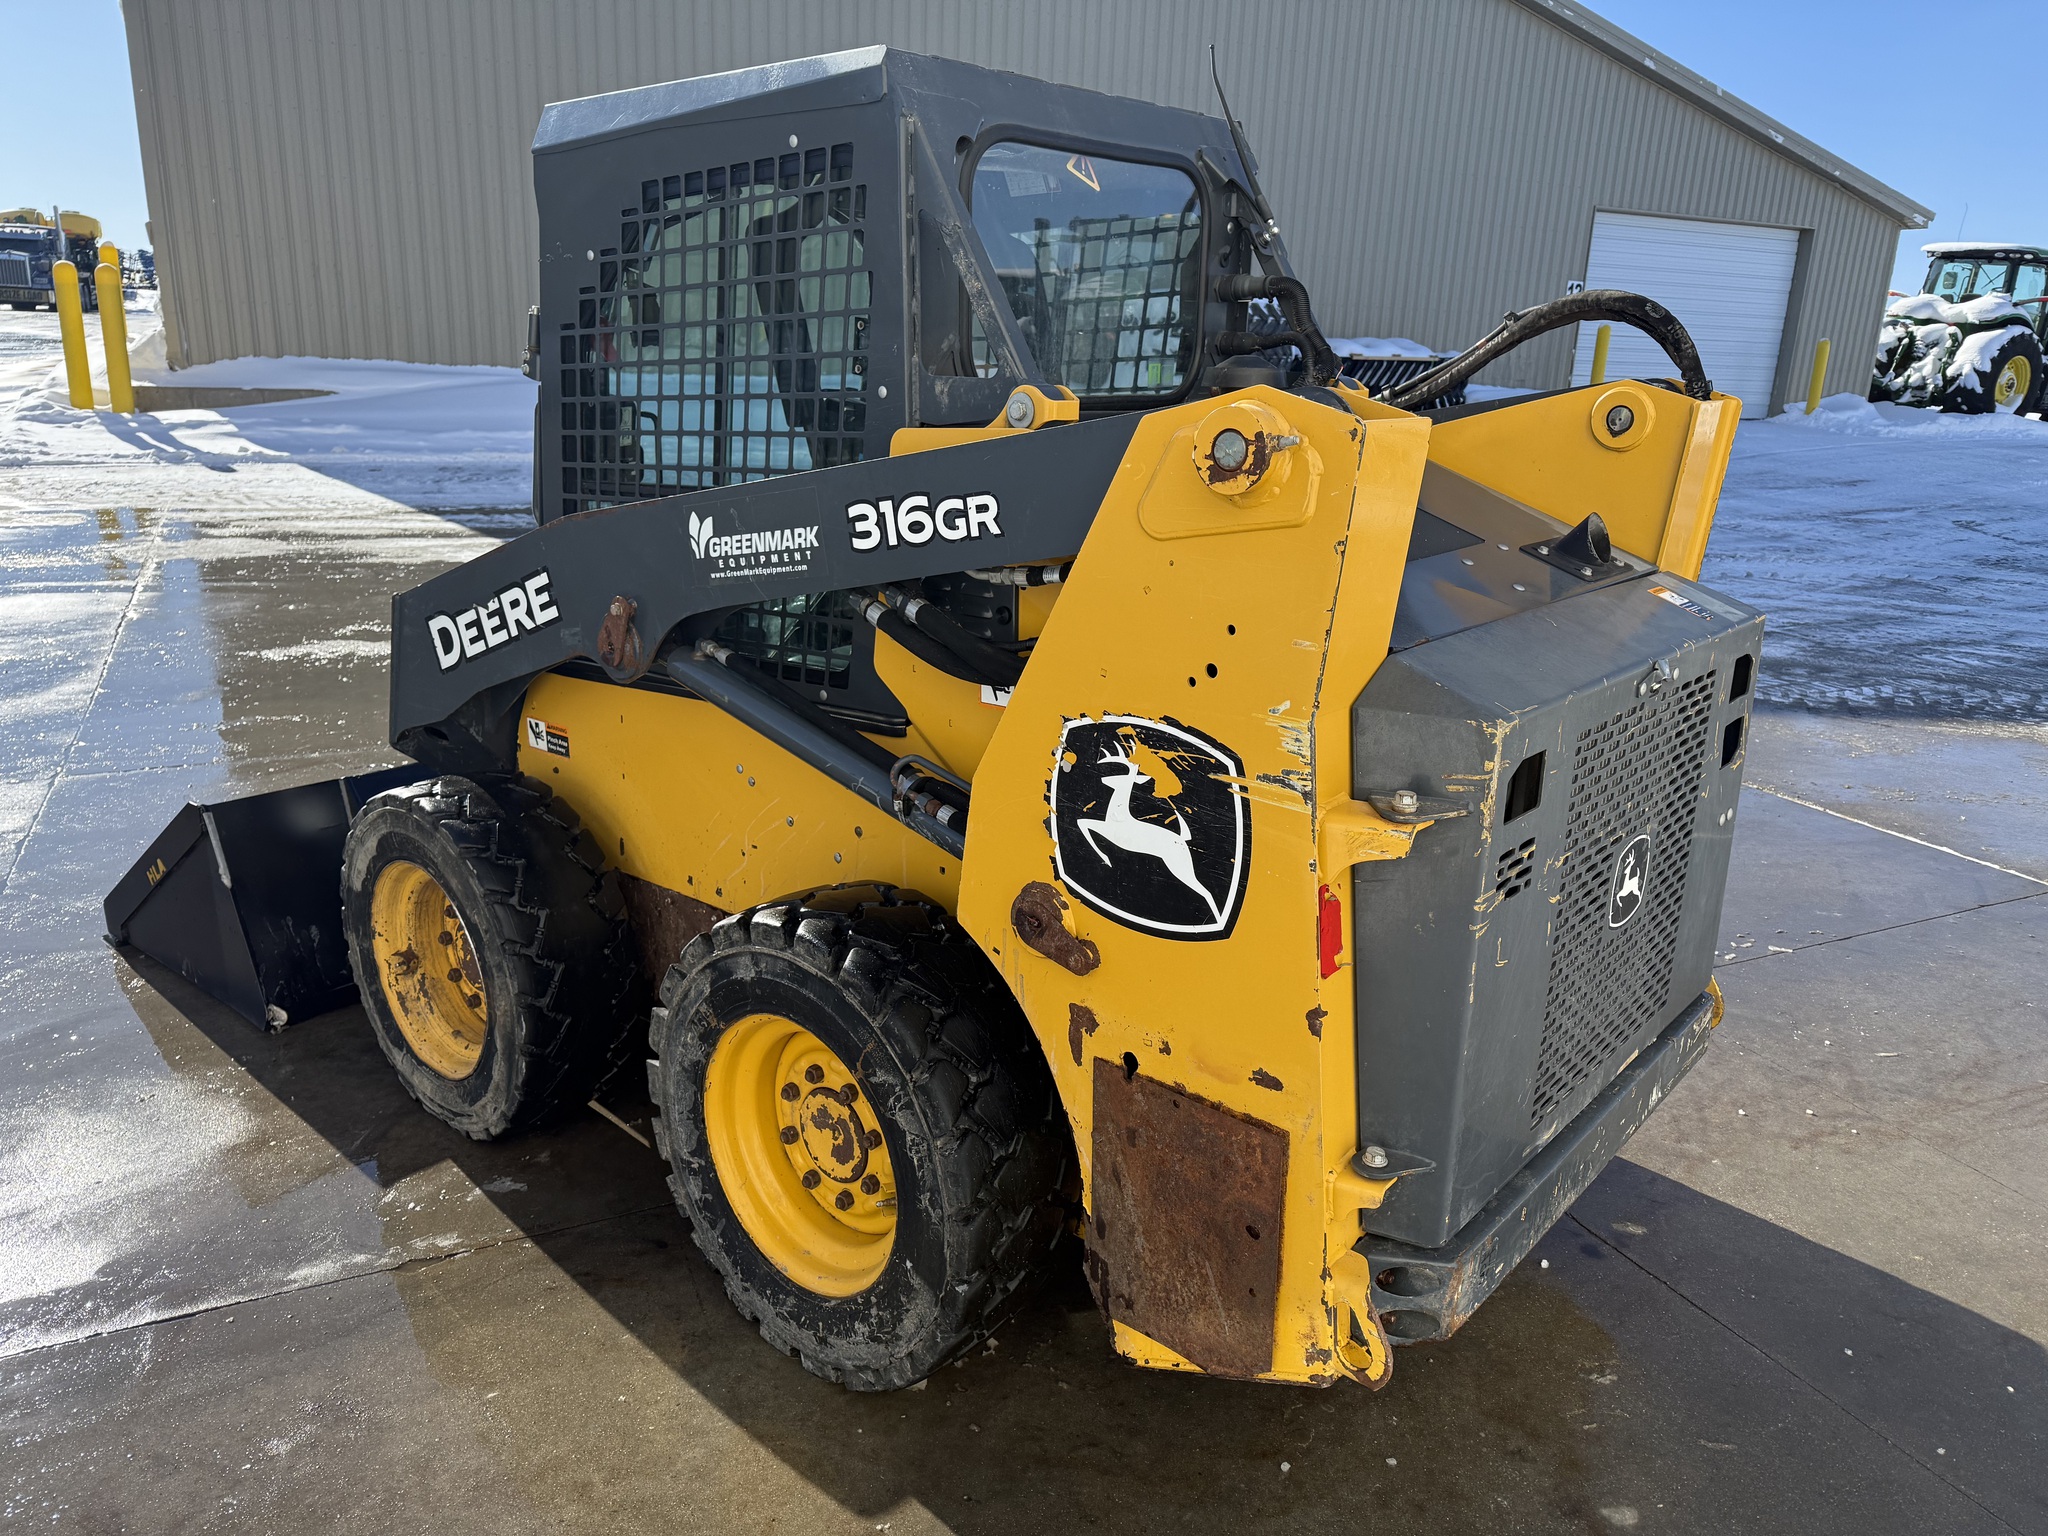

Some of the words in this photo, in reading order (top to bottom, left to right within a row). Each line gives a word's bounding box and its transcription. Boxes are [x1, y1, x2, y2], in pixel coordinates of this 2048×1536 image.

[847, 494, 1001, 550] 316GR
[709, 525, 819, 557] GREENMARK
[710, 564, 808, 579] www.GreenMarkEquipment.com
[718, 551, 811, 568] EQUIPMENT
[428, 572, 559, 670] DEERE
[146, 857, 167, 886] HLA
